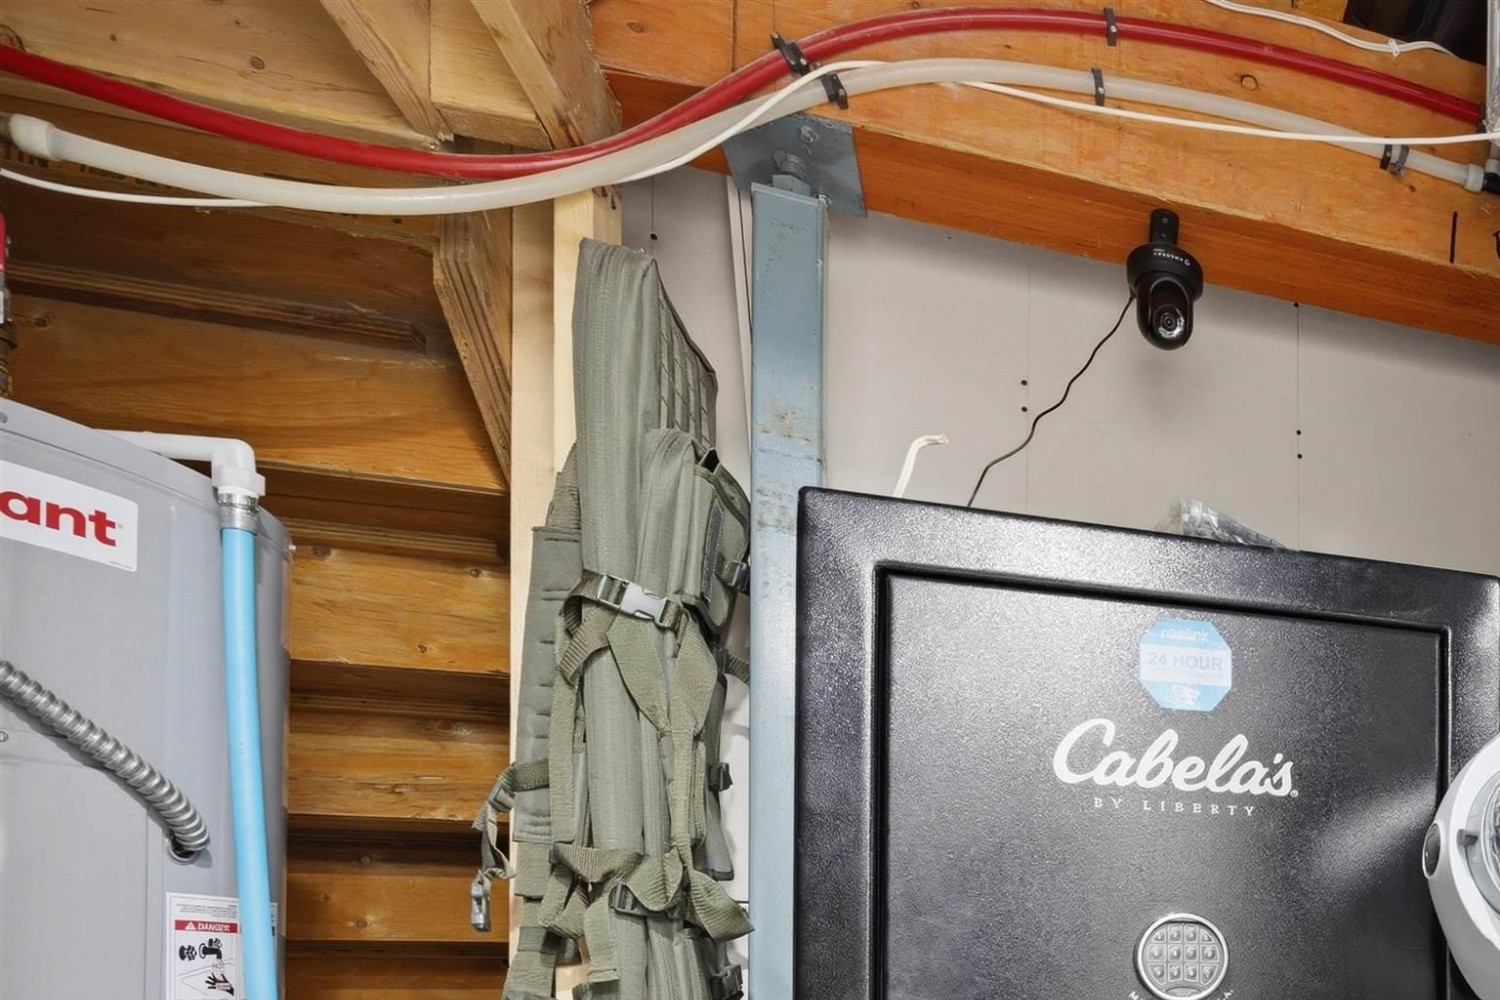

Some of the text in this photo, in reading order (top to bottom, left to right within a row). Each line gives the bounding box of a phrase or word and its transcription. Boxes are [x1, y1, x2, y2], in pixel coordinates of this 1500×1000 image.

[1148, 652, 1223, 671] 24 HOUR
[1053, 718, 1294, 798] Cabela's
[1094, 798, 1256, 816] BY LIBERTY
